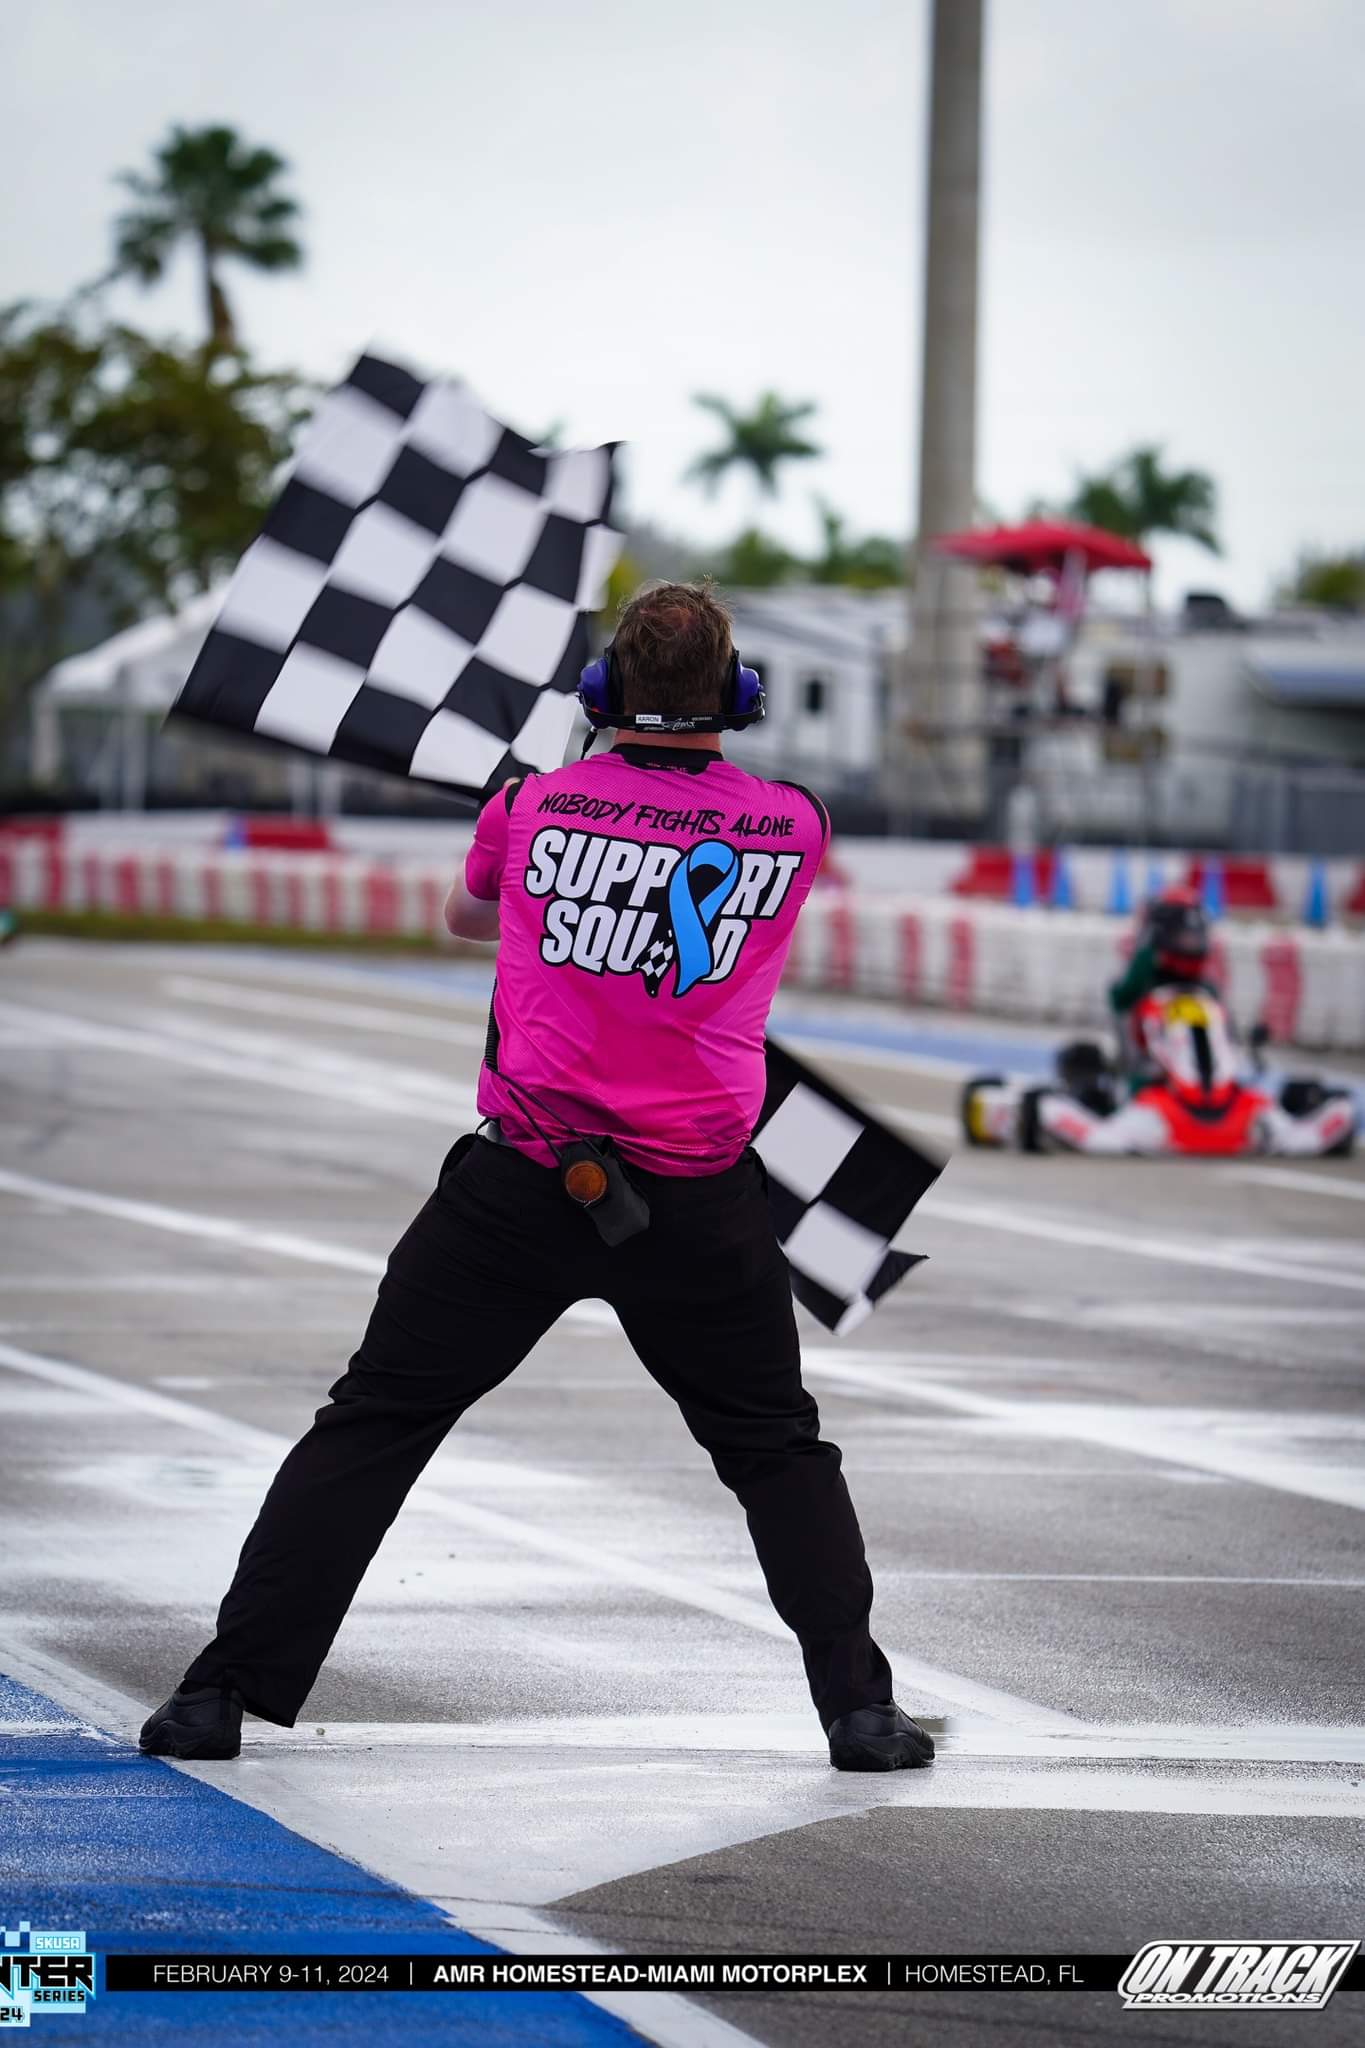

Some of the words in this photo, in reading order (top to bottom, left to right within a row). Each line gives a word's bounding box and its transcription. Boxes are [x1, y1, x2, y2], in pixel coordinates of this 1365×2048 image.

[537, 793, 635, 825] NOBODY
[634, 805, 726, 836] FIGHTS
[729, 813, 795, 838] ALONE
